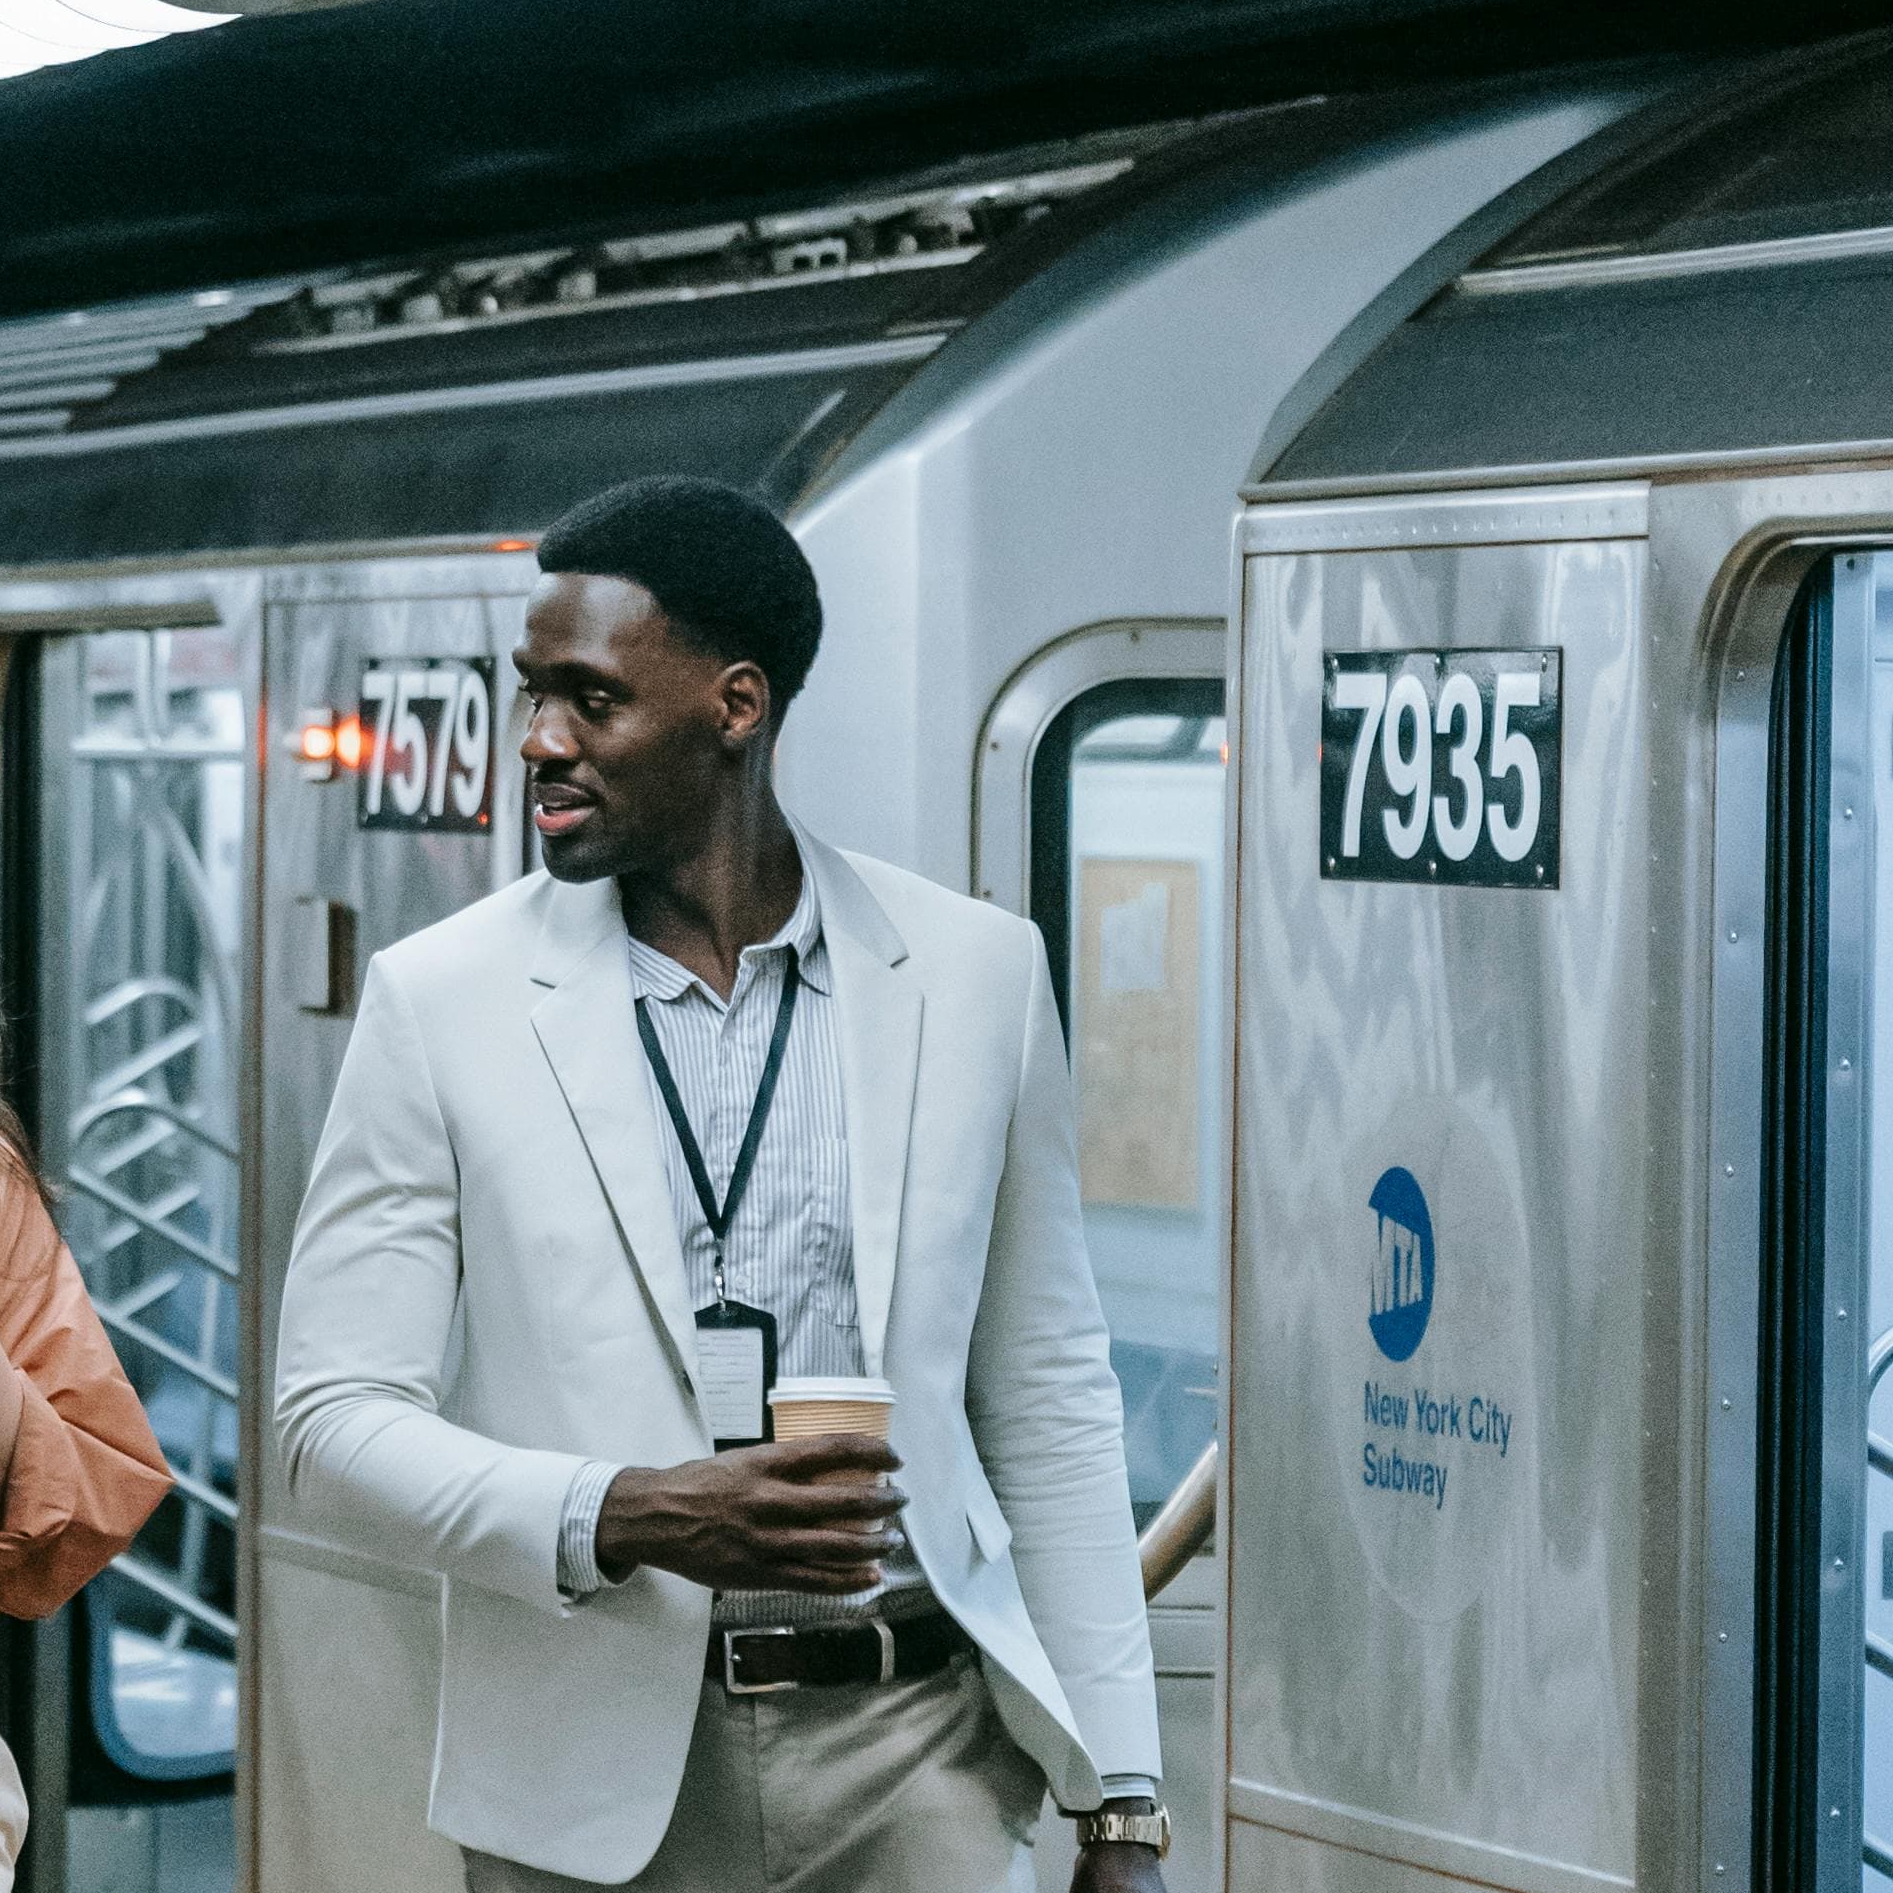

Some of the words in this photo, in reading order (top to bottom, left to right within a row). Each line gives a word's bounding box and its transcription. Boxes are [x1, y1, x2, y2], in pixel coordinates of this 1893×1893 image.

[362, 669, 490, 818] 7579
[1335, 672, 1542, 862] 7935
[1363, 1442, 1448, 1510] Subway
[1364, 1381, 1408, 1430] New
[1414, 1388, 1462, 1438] York
[1468, 1395, 1512, 1458] City
